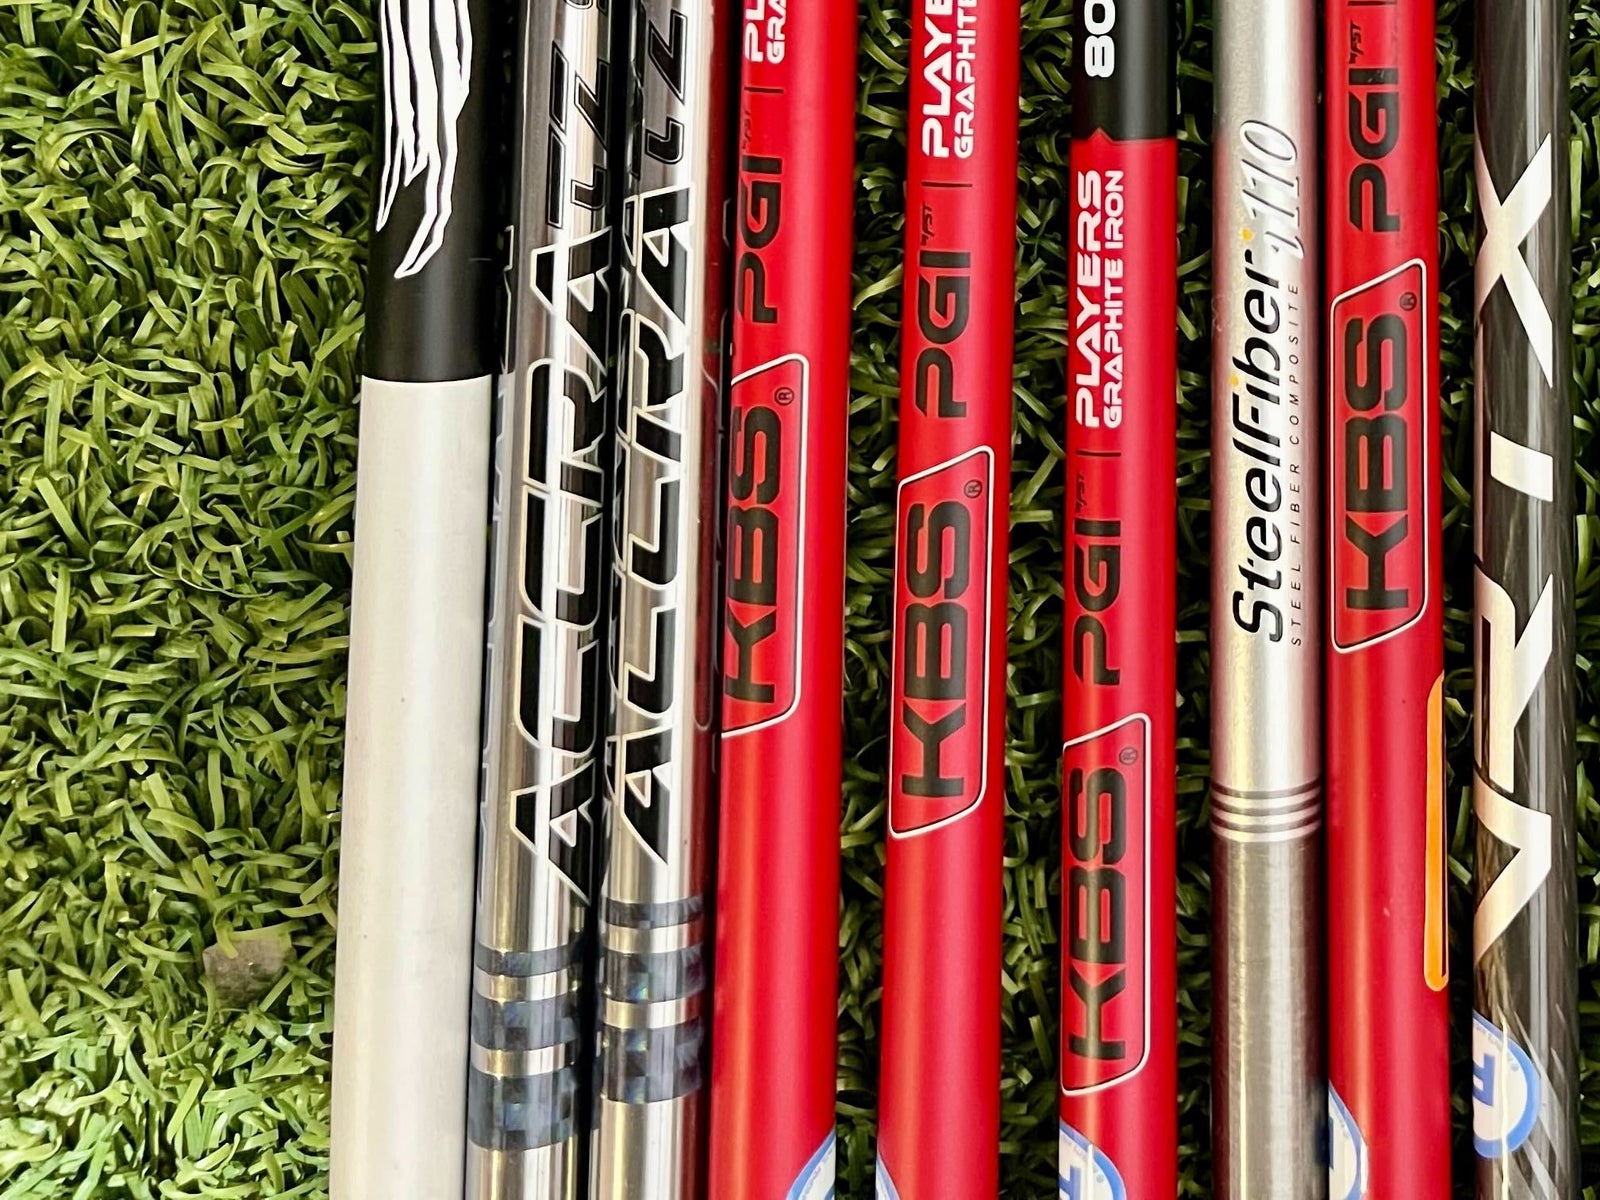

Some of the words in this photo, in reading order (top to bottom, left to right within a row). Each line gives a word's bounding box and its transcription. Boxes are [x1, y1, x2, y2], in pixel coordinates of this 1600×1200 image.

[1104, 170, 1125, 251] IRON
[1240, 119, 1304, 261] i110
[1347, 67, 1401, 234] PGI
[738, 155, 784, 325] PGI
[1075, 169, 1102, 428] PLAYERS
[914, 250, 971, 418] PGI
[1103, 257, 1124, 429] GRAPHITE
[1287, 282, 1300, 445] COMPOSITE
[606, 185, 693, 865] ACCRA
[1230, 249, 1284, 642] SteelFiber
[1290, 463, 1302, 544] FIBER
[1344, 312, 1409, 612] KBS
[510, 225, 613, 903] ACCRA
[725, 404, 781, 704] KBS
[1073, 518, 1121, 687] PGI
[1291, 563, 1302, 647] STEEL
[902, 502, 970, 799] KBS
[1068, 765, 1127, 1061] KBS
